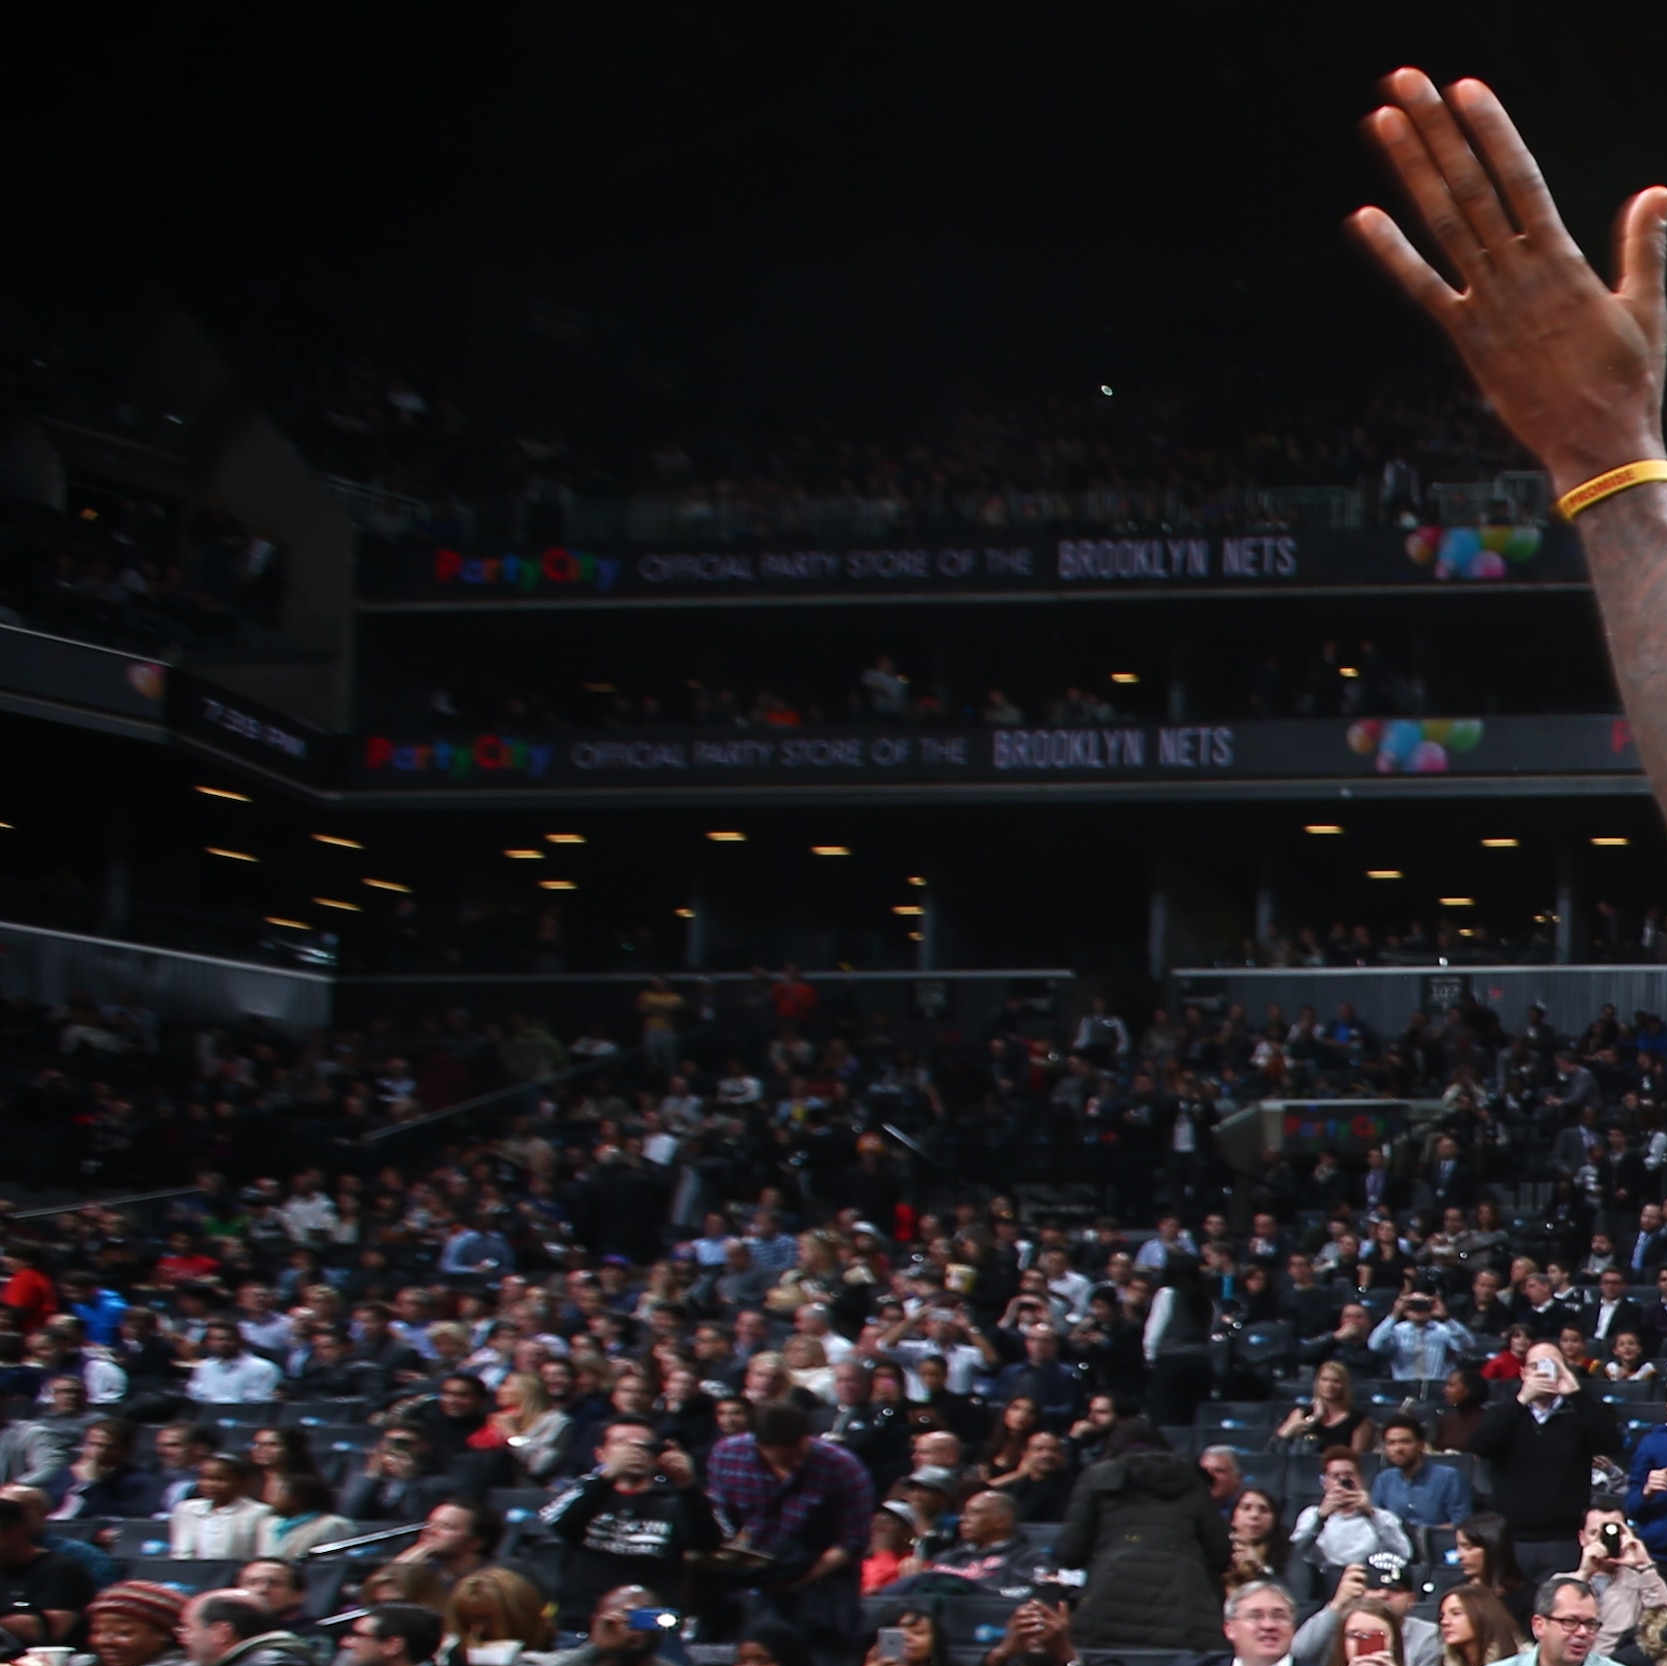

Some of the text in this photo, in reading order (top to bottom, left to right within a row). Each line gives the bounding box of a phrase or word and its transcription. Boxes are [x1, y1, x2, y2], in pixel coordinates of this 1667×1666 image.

[637, 552, 755, 583] OFFICIAL
[761, 551, 842, 581] PARTY
[847, 549, 929, 579] STORE
[936, 548, 979, 577] OF
[985, 547, 1034, 576] THE
[1057, 538, 1210, 580] BROOKLYN
[1221, 535, 1298, 578] NETS
[570, 740, 688, 770] OFFICIAL
[693, 739, 776, 769] PARTY
[780, 738, 864, 768] STORE
[870, 737, 914, 767] OF
[921, 736, 968, 766] THE
[991, 729, 1145, 770] BROOKLYN
[1157, 726, 1234, 769] NETS
